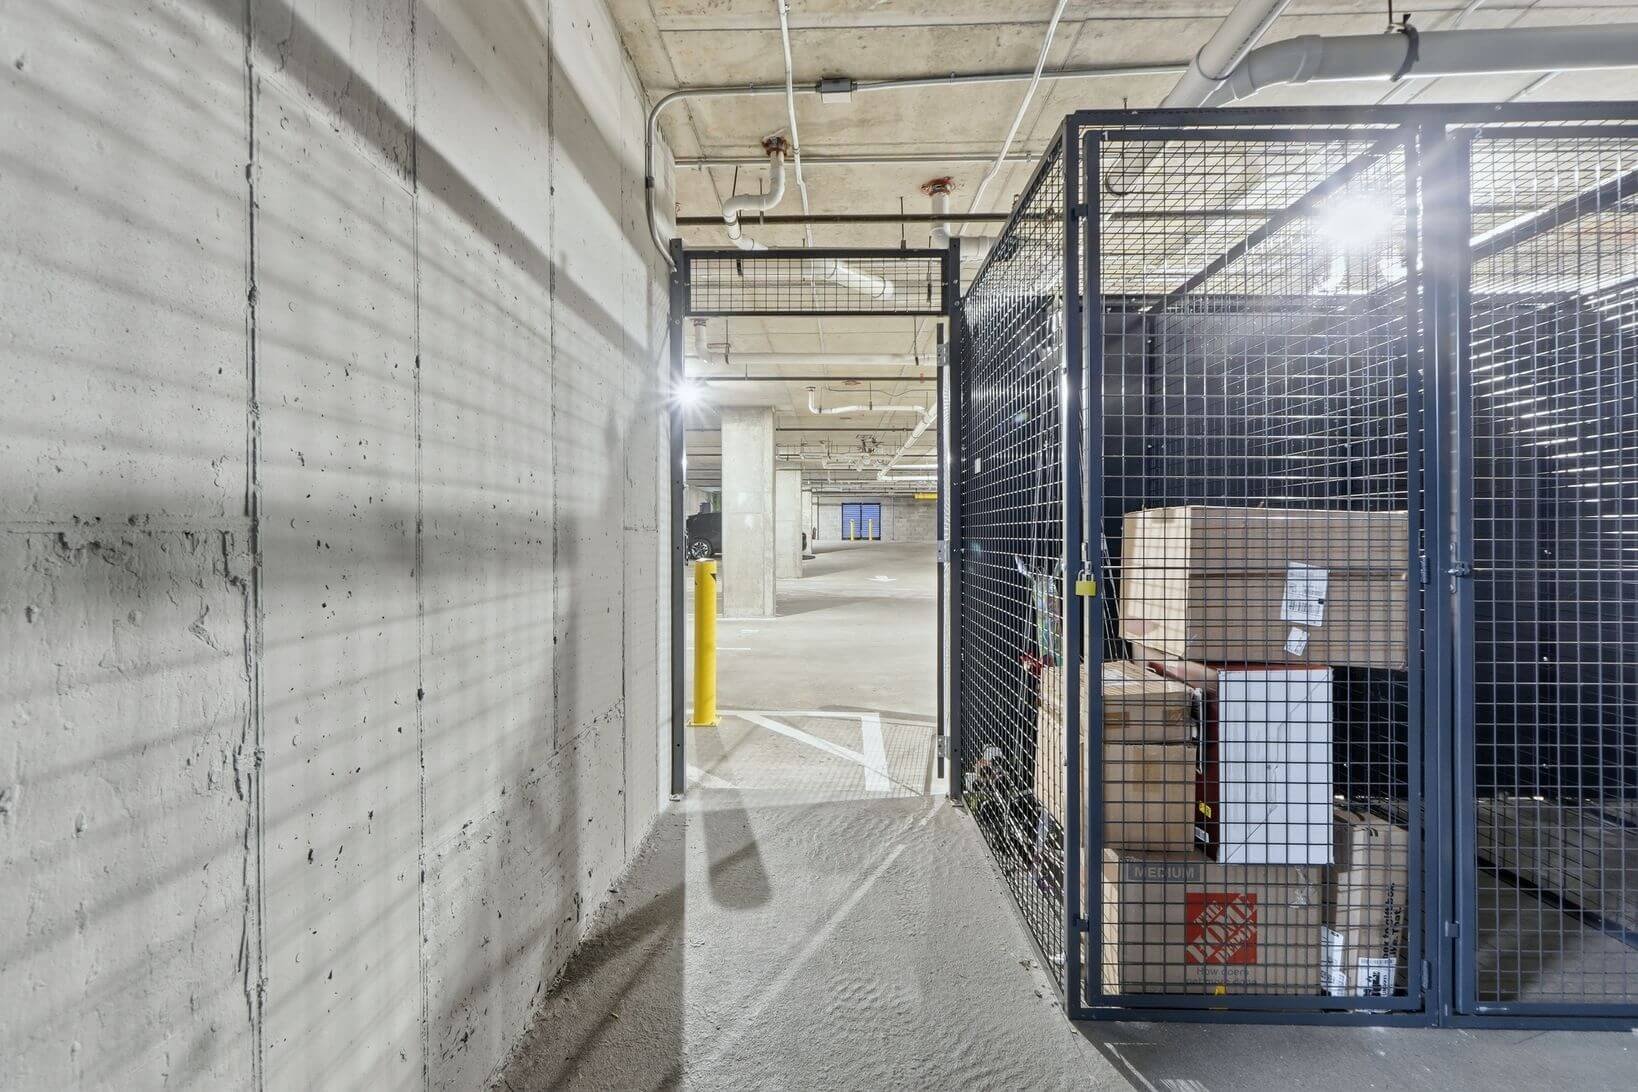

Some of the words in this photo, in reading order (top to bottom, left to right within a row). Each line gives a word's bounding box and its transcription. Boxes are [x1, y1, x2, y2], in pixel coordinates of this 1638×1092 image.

[1102, 130, 1109, 141] 1
[1475, 127, 1483, 138] 2
[1134, 866, 1195, 879] MEDIUM
[1186, 893, 1258, 963] HOME
[1196, 966, 1219, 976] How
